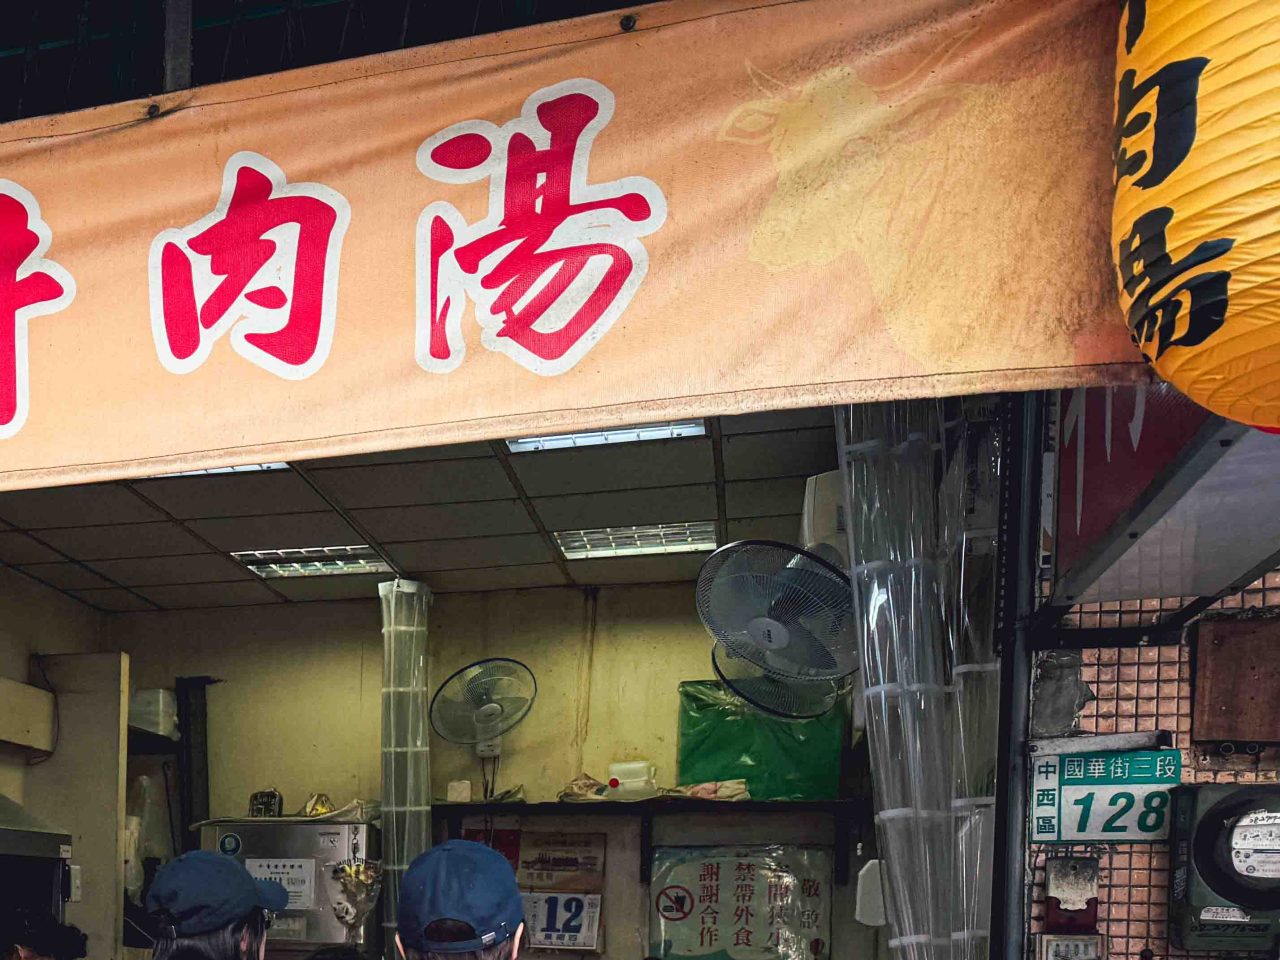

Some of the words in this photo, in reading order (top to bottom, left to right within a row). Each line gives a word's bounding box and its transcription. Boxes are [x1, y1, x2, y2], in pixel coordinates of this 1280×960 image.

[1118, 0, 1236, 364] 肉湯
[1036, 761, 1056, 834] 中西區
[1064, 756, 1176, 780] 國華街三段
[1073, 791, 1169, 833] 128
[541, 896, 584, 933] 12
[699, 862, 720, 947] 謝謝合作
[733, 862, 756, 947] 禁帶外食
